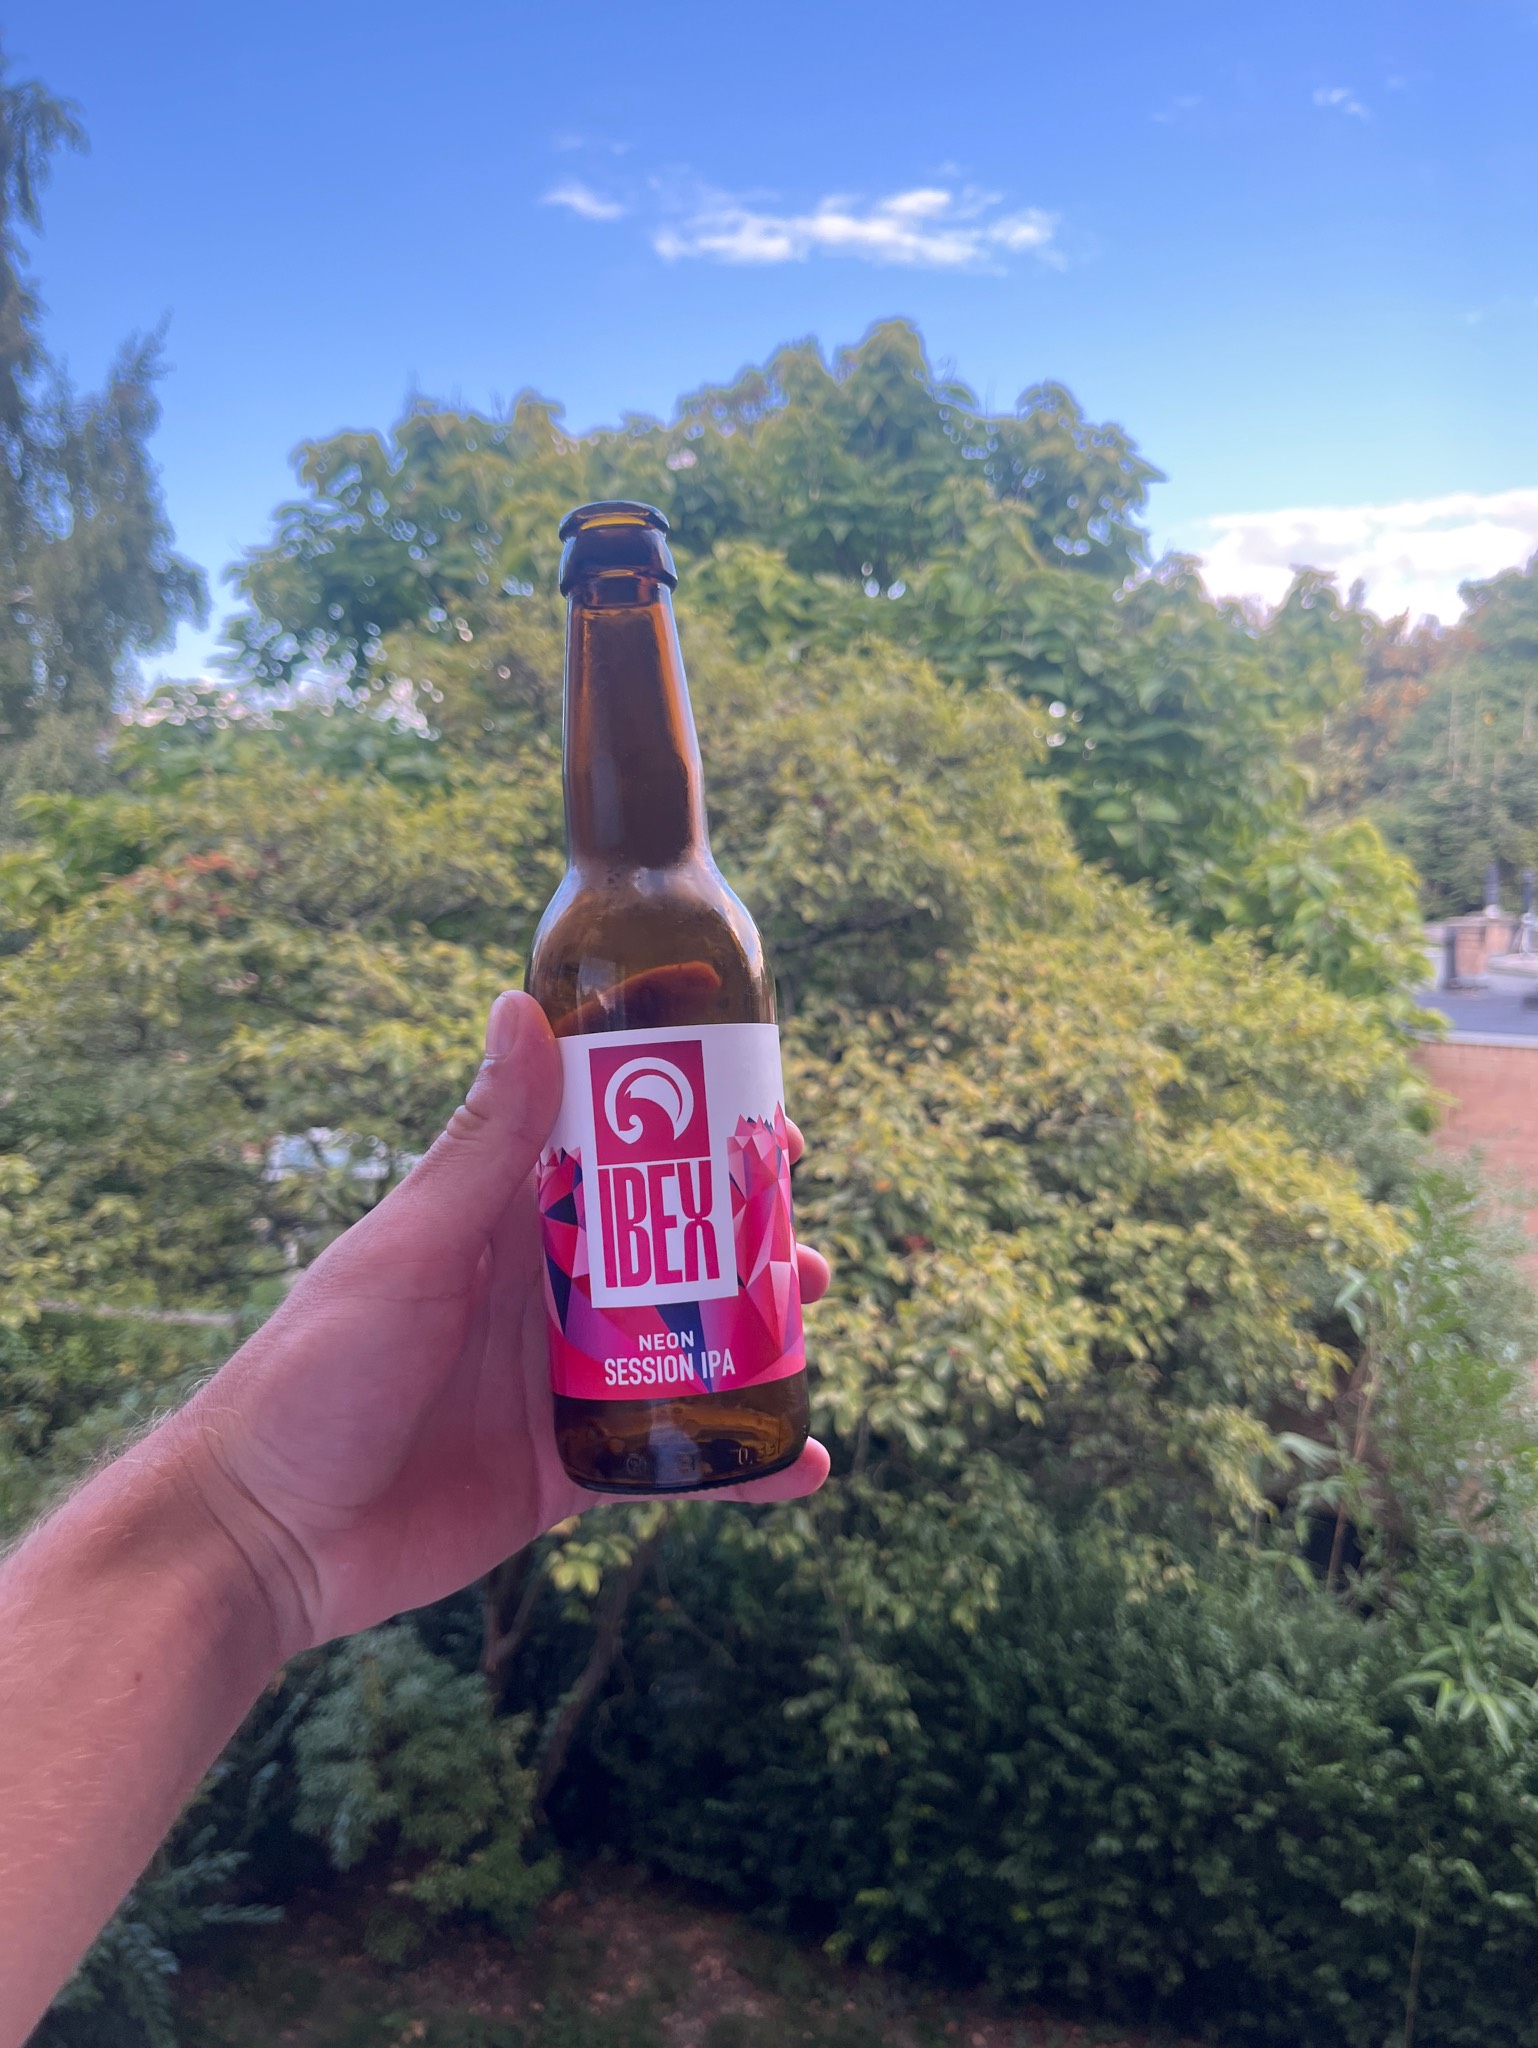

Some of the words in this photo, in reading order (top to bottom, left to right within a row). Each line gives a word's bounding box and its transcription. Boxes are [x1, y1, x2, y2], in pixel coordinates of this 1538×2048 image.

[597, 1161, 720, 1288] IBEX
[638, 1331, 694, 1350] NEON
[604, 1353, 694, 1386] SESSION
[702, 1349, 736, 1379] IPA
